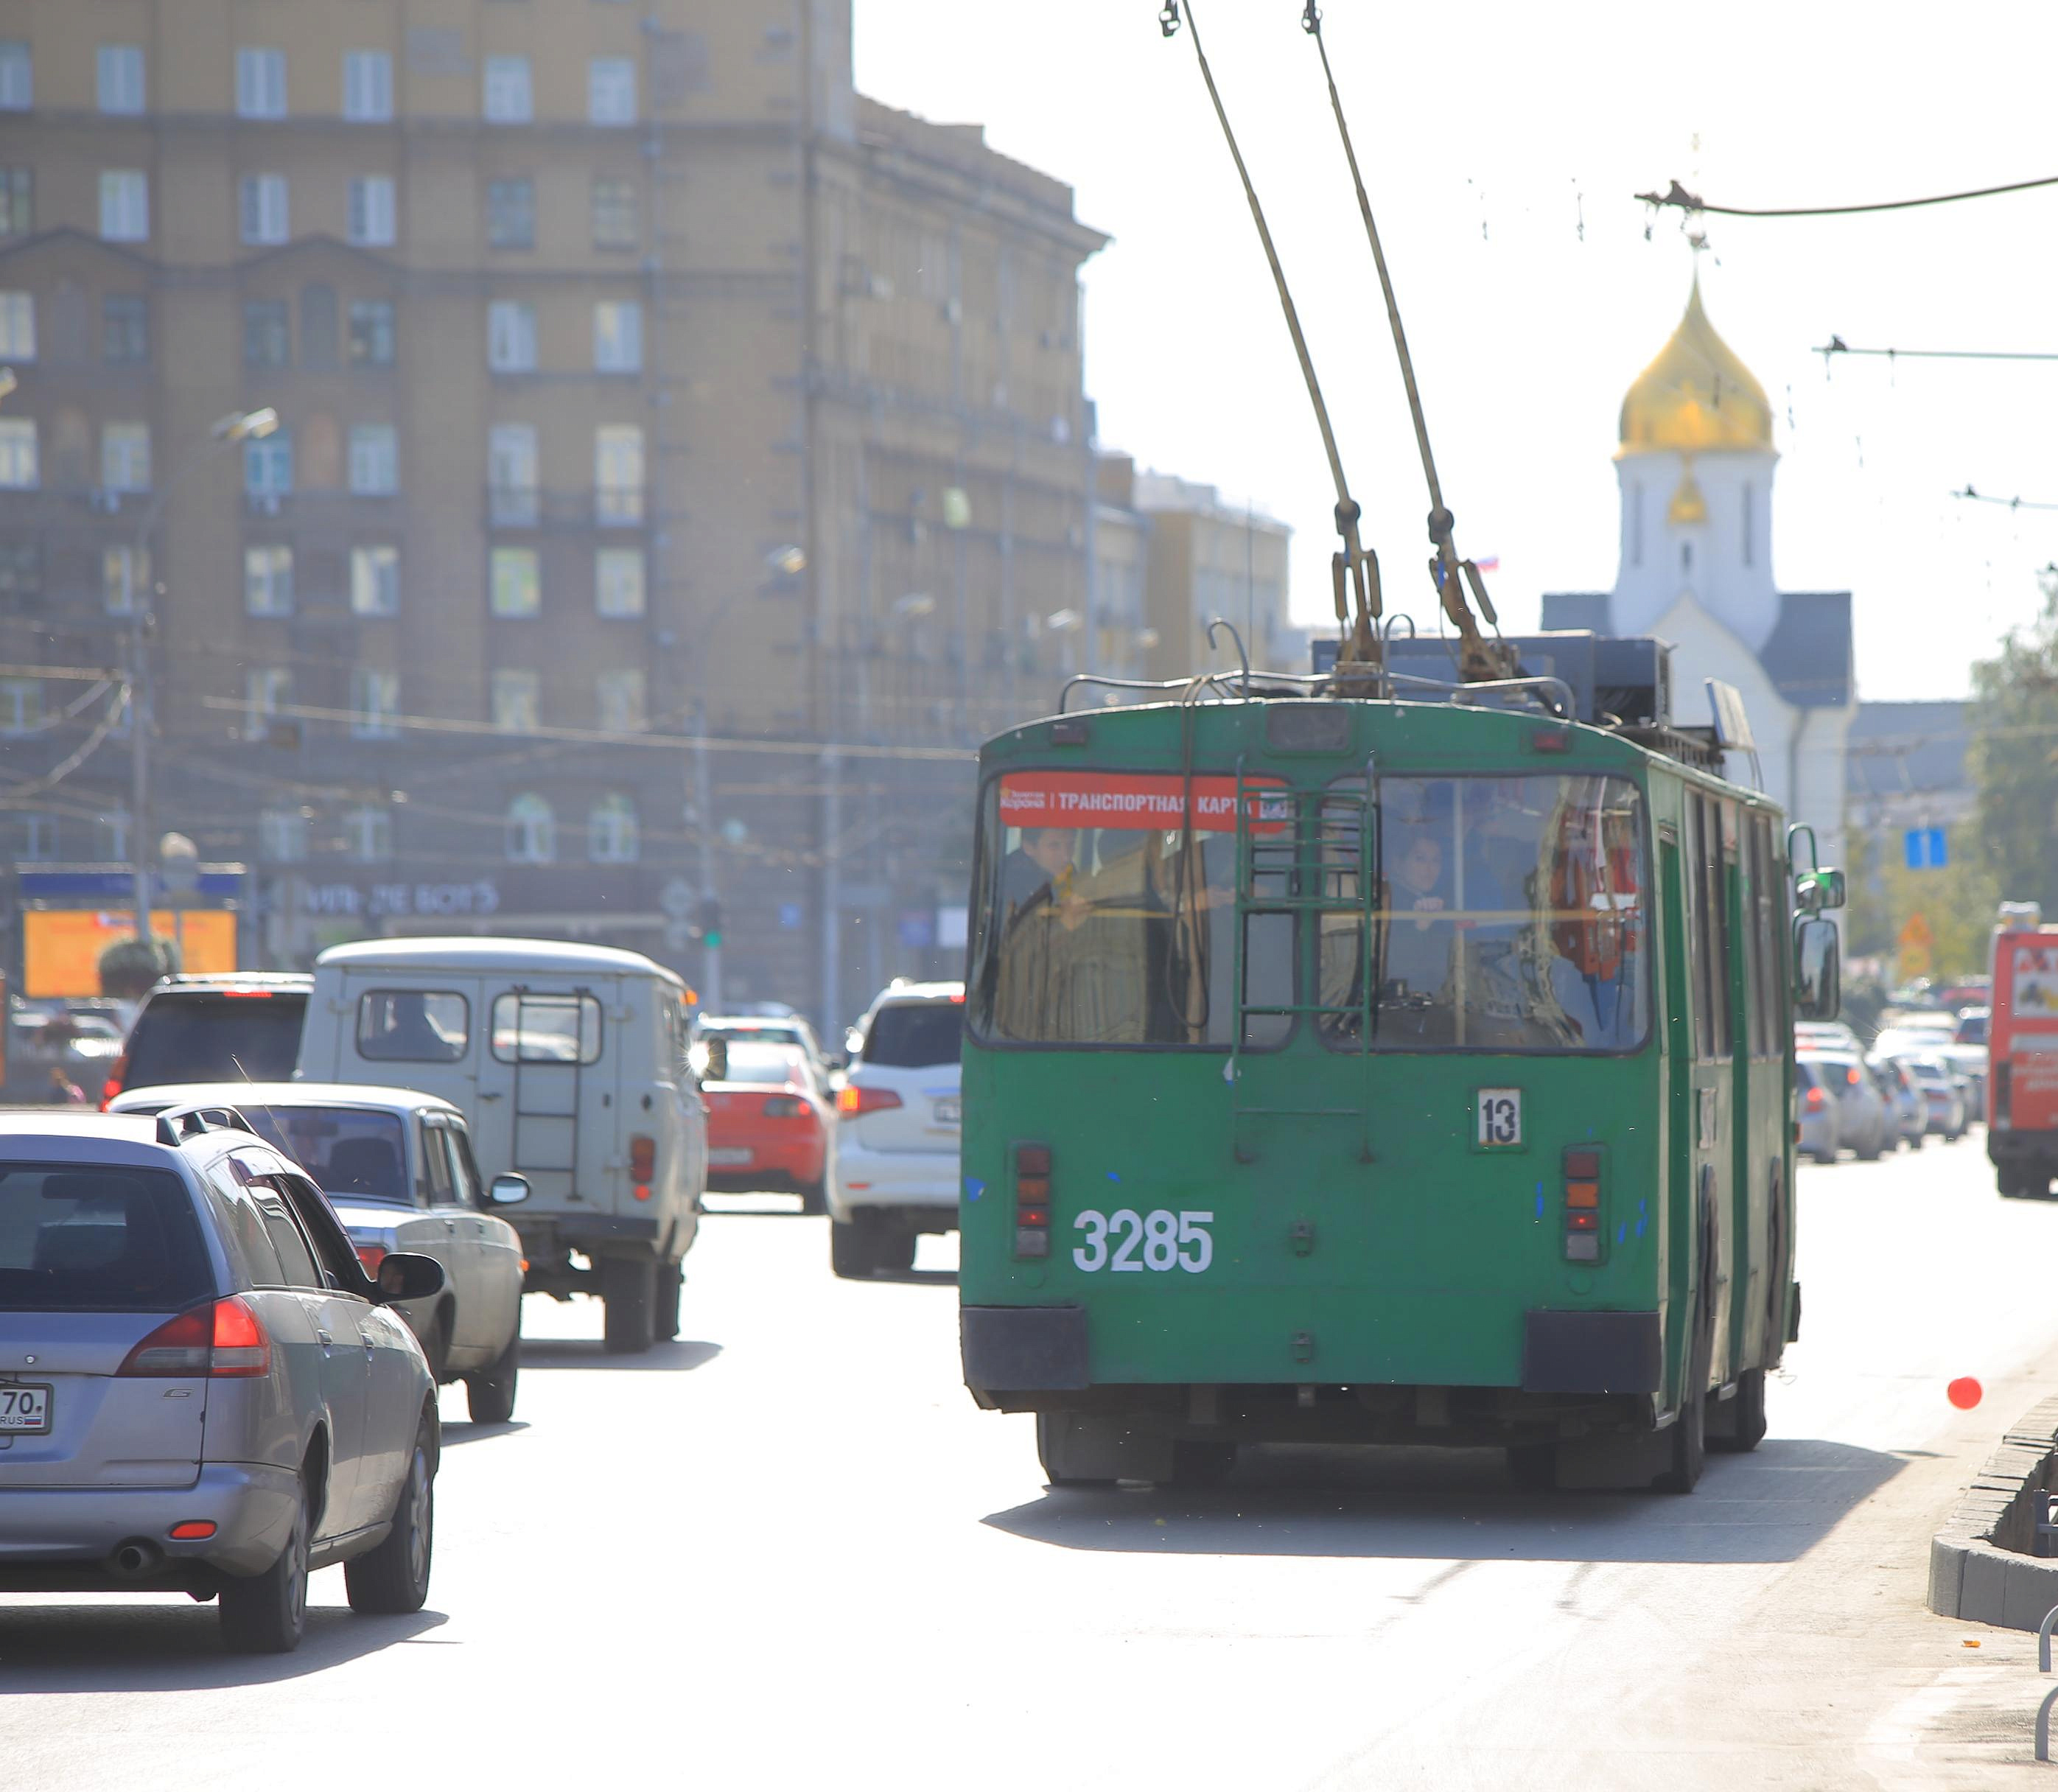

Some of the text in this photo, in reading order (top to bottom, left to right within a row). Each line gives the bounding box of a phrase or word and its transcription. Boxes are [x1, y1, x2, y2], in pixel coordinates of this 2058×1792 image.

[1483, 1099, 1515, 1143] 13
[1073, 1209, 1214, 1273] 3285
[3, 1391, 34, 1415] 70
[0, 1416, 24, 1425] RUS
